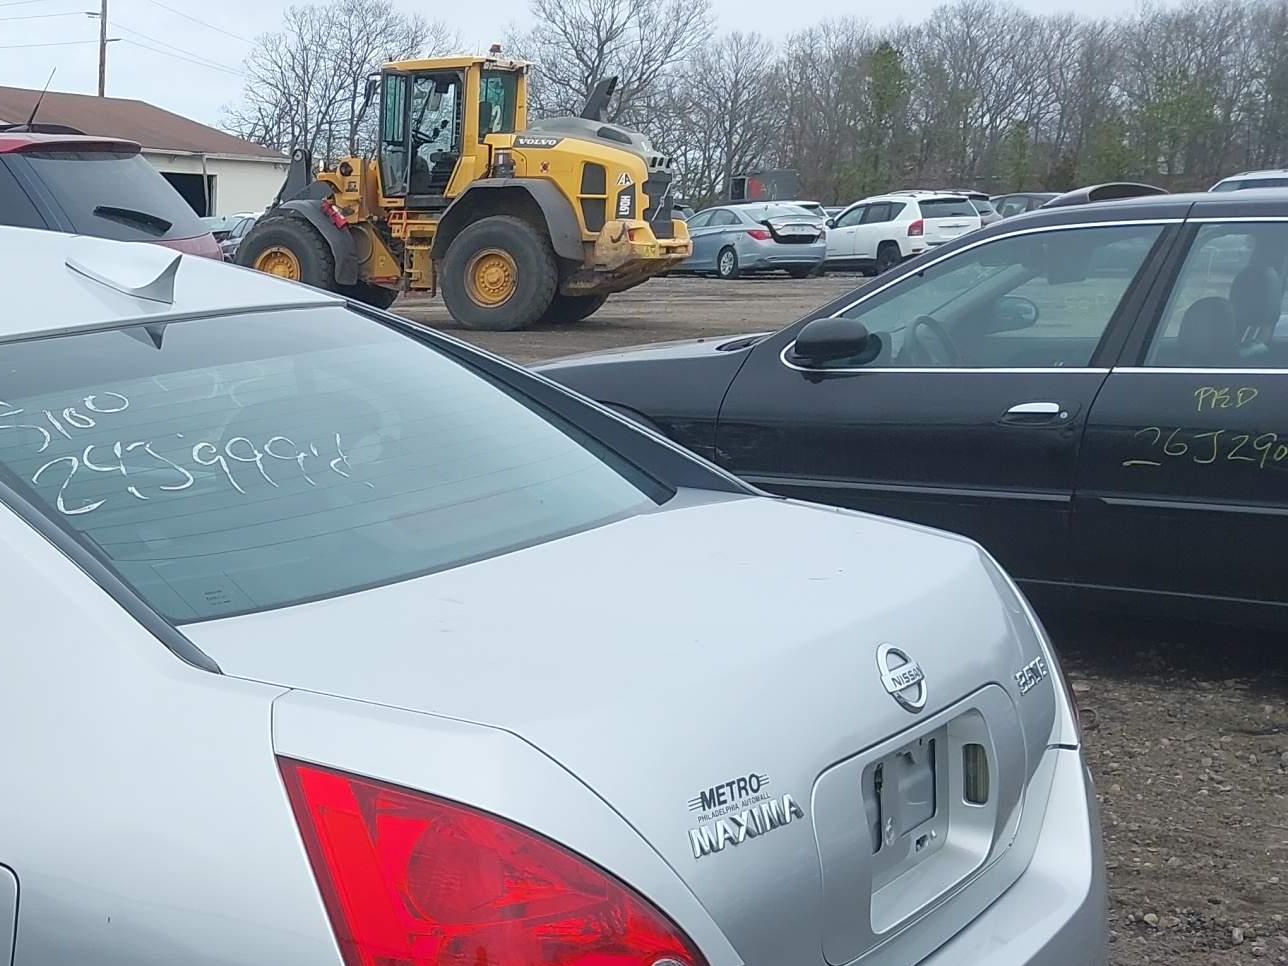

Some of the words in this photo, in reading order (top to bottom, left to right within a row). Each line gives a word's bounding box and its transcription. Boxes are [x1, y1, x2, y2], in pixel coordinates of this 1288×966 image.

[518, 138, 557, 146] VOLVO
[697, 803, 740, 823] PHILADELPHIA
[741, 791, 771, 807] AUTOMALL
[700, 773, 761, 811] METRO
[688, 793, 805, 859] MAXIMA
